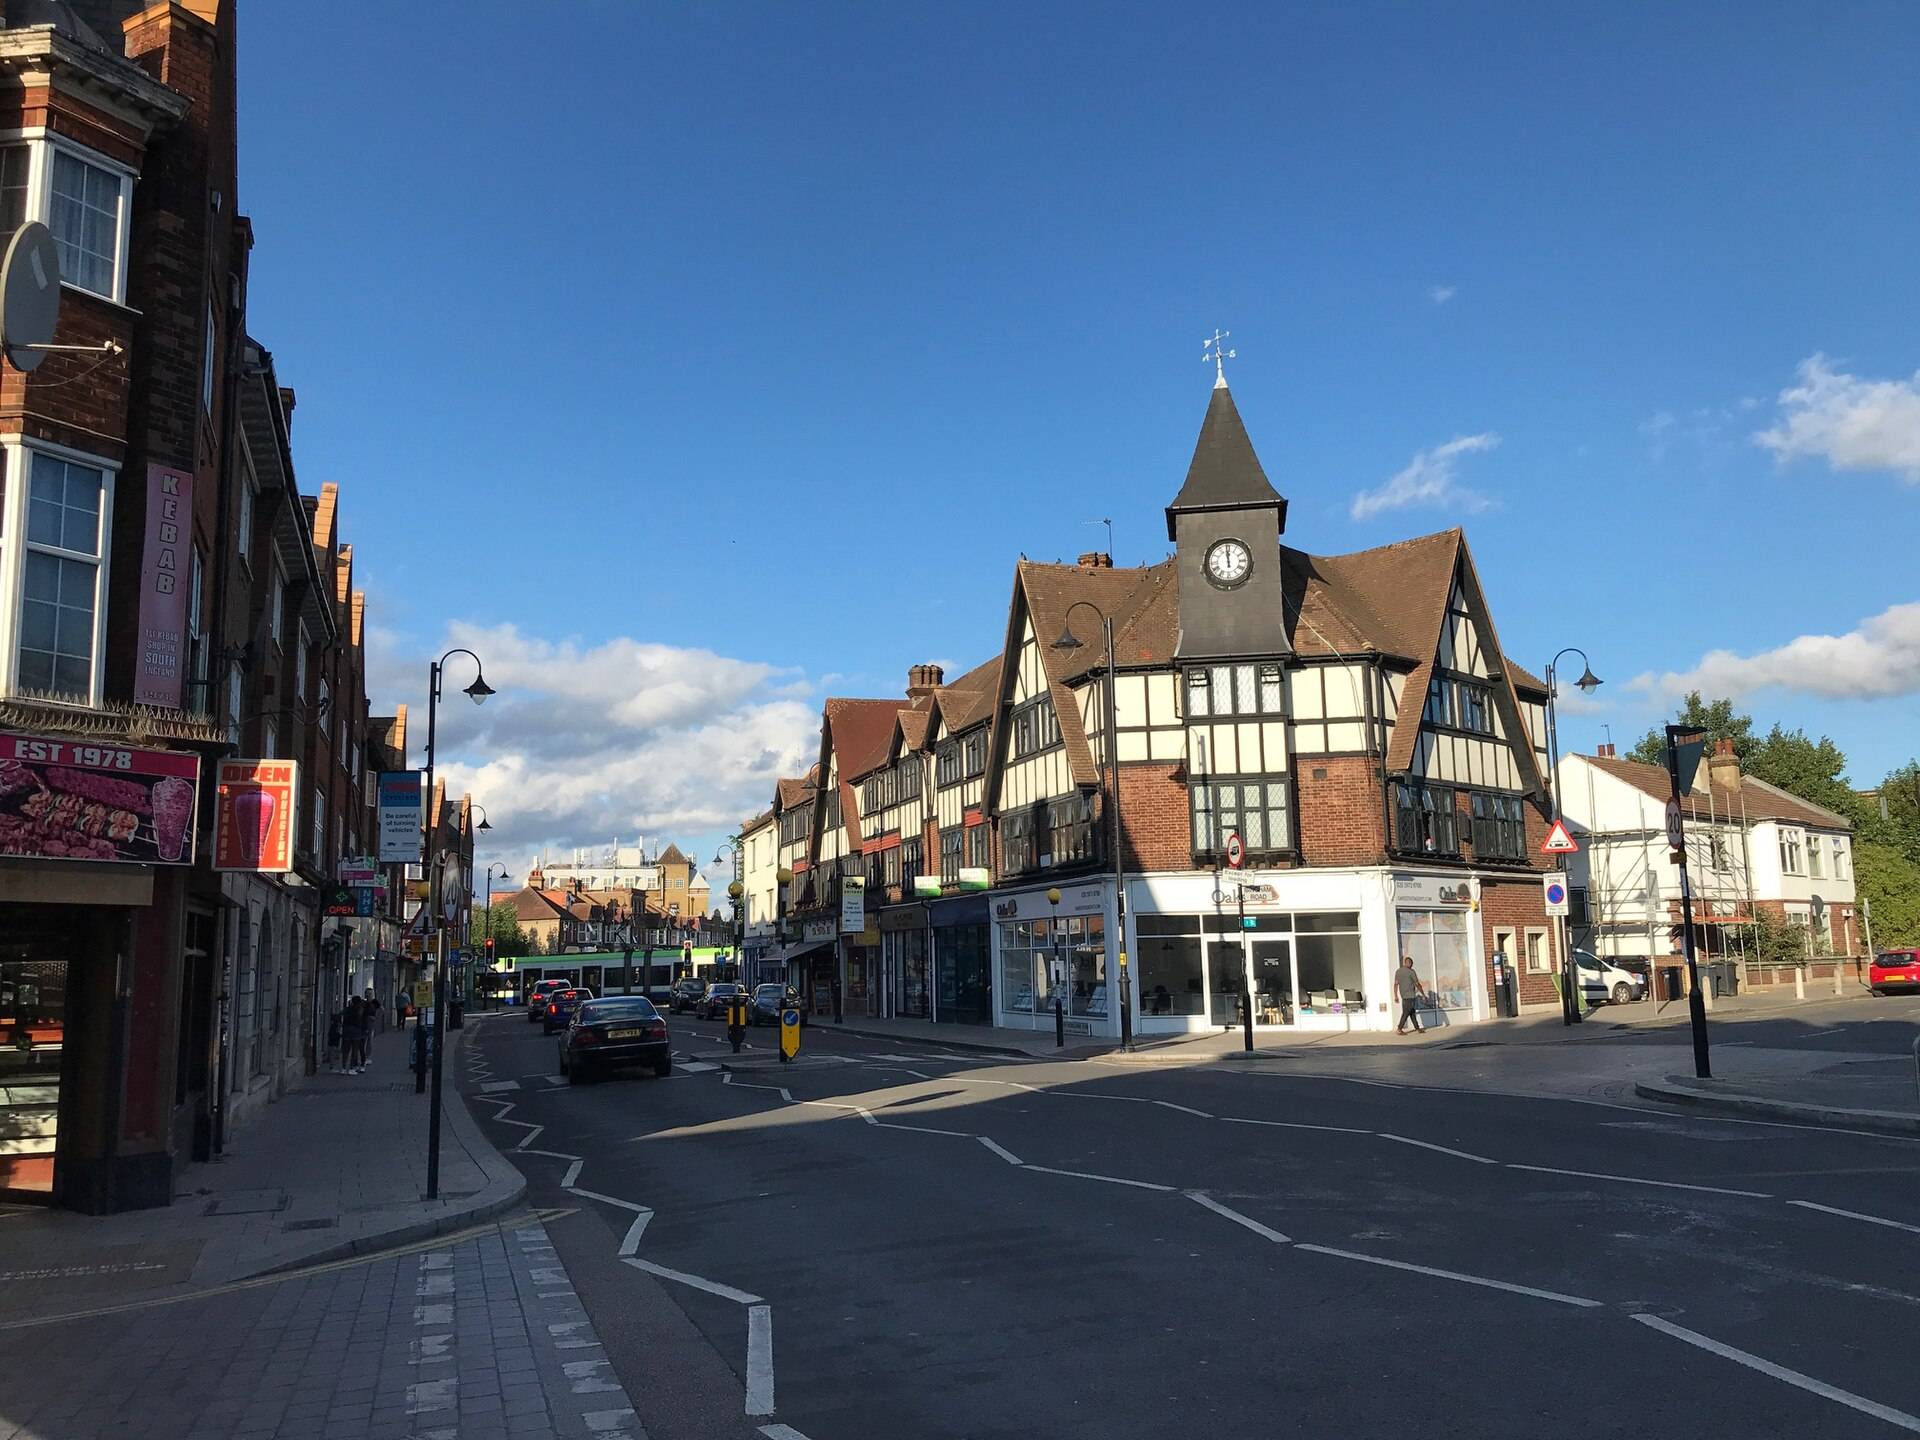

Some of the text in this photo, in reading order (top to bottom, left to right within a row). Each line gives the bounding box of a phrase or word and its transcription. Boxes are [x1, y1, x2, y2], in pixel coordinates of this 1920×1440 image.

[156, 473, 180, 595] KEBAB
[145, 652, 176, 667] SOUTH
[15, 739, 133, 769] EST 1978
[222, 765, 292, 782] OPEN
[1667, 812, 1680, 834] 20
[361, 888, 372, 914] NHS
[445, 883, 458, 906] 20
[1250, 892, 1268, 900] ROAD
[328, 904, 355, 914] OPEN
